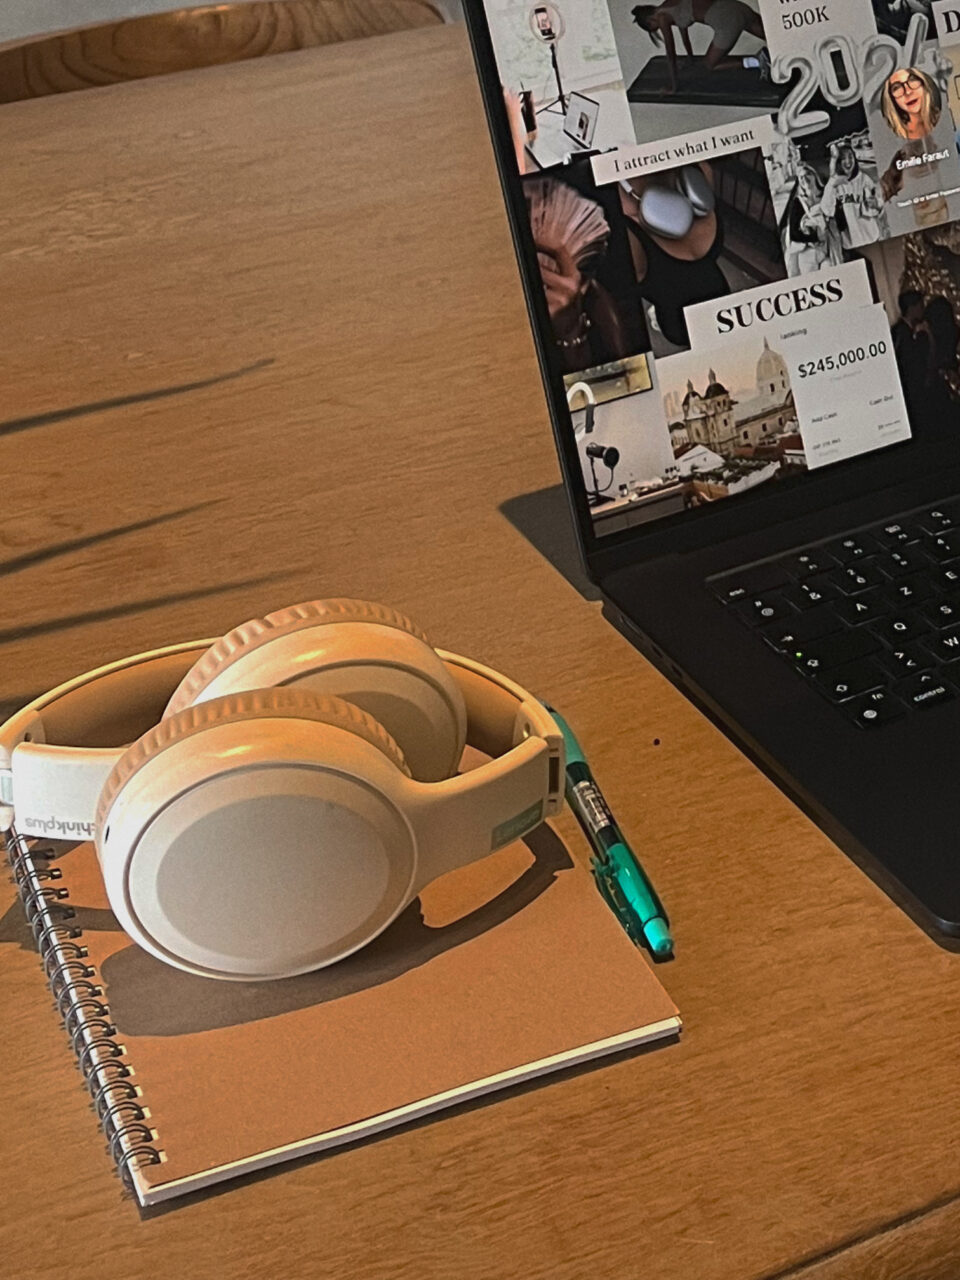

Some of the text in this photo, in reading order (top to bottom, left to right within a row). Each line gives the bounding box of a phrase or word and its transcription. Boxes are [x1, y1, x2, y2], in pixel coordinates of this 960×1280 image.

[782, 5, 830, 30] 500K
[614, 130, 755, 172] I attract what I want
[716, 279, 843, 334] SUCCESS
[798, 341, 887, 378] $245,000.00
[914, 687, 945, 701] control
